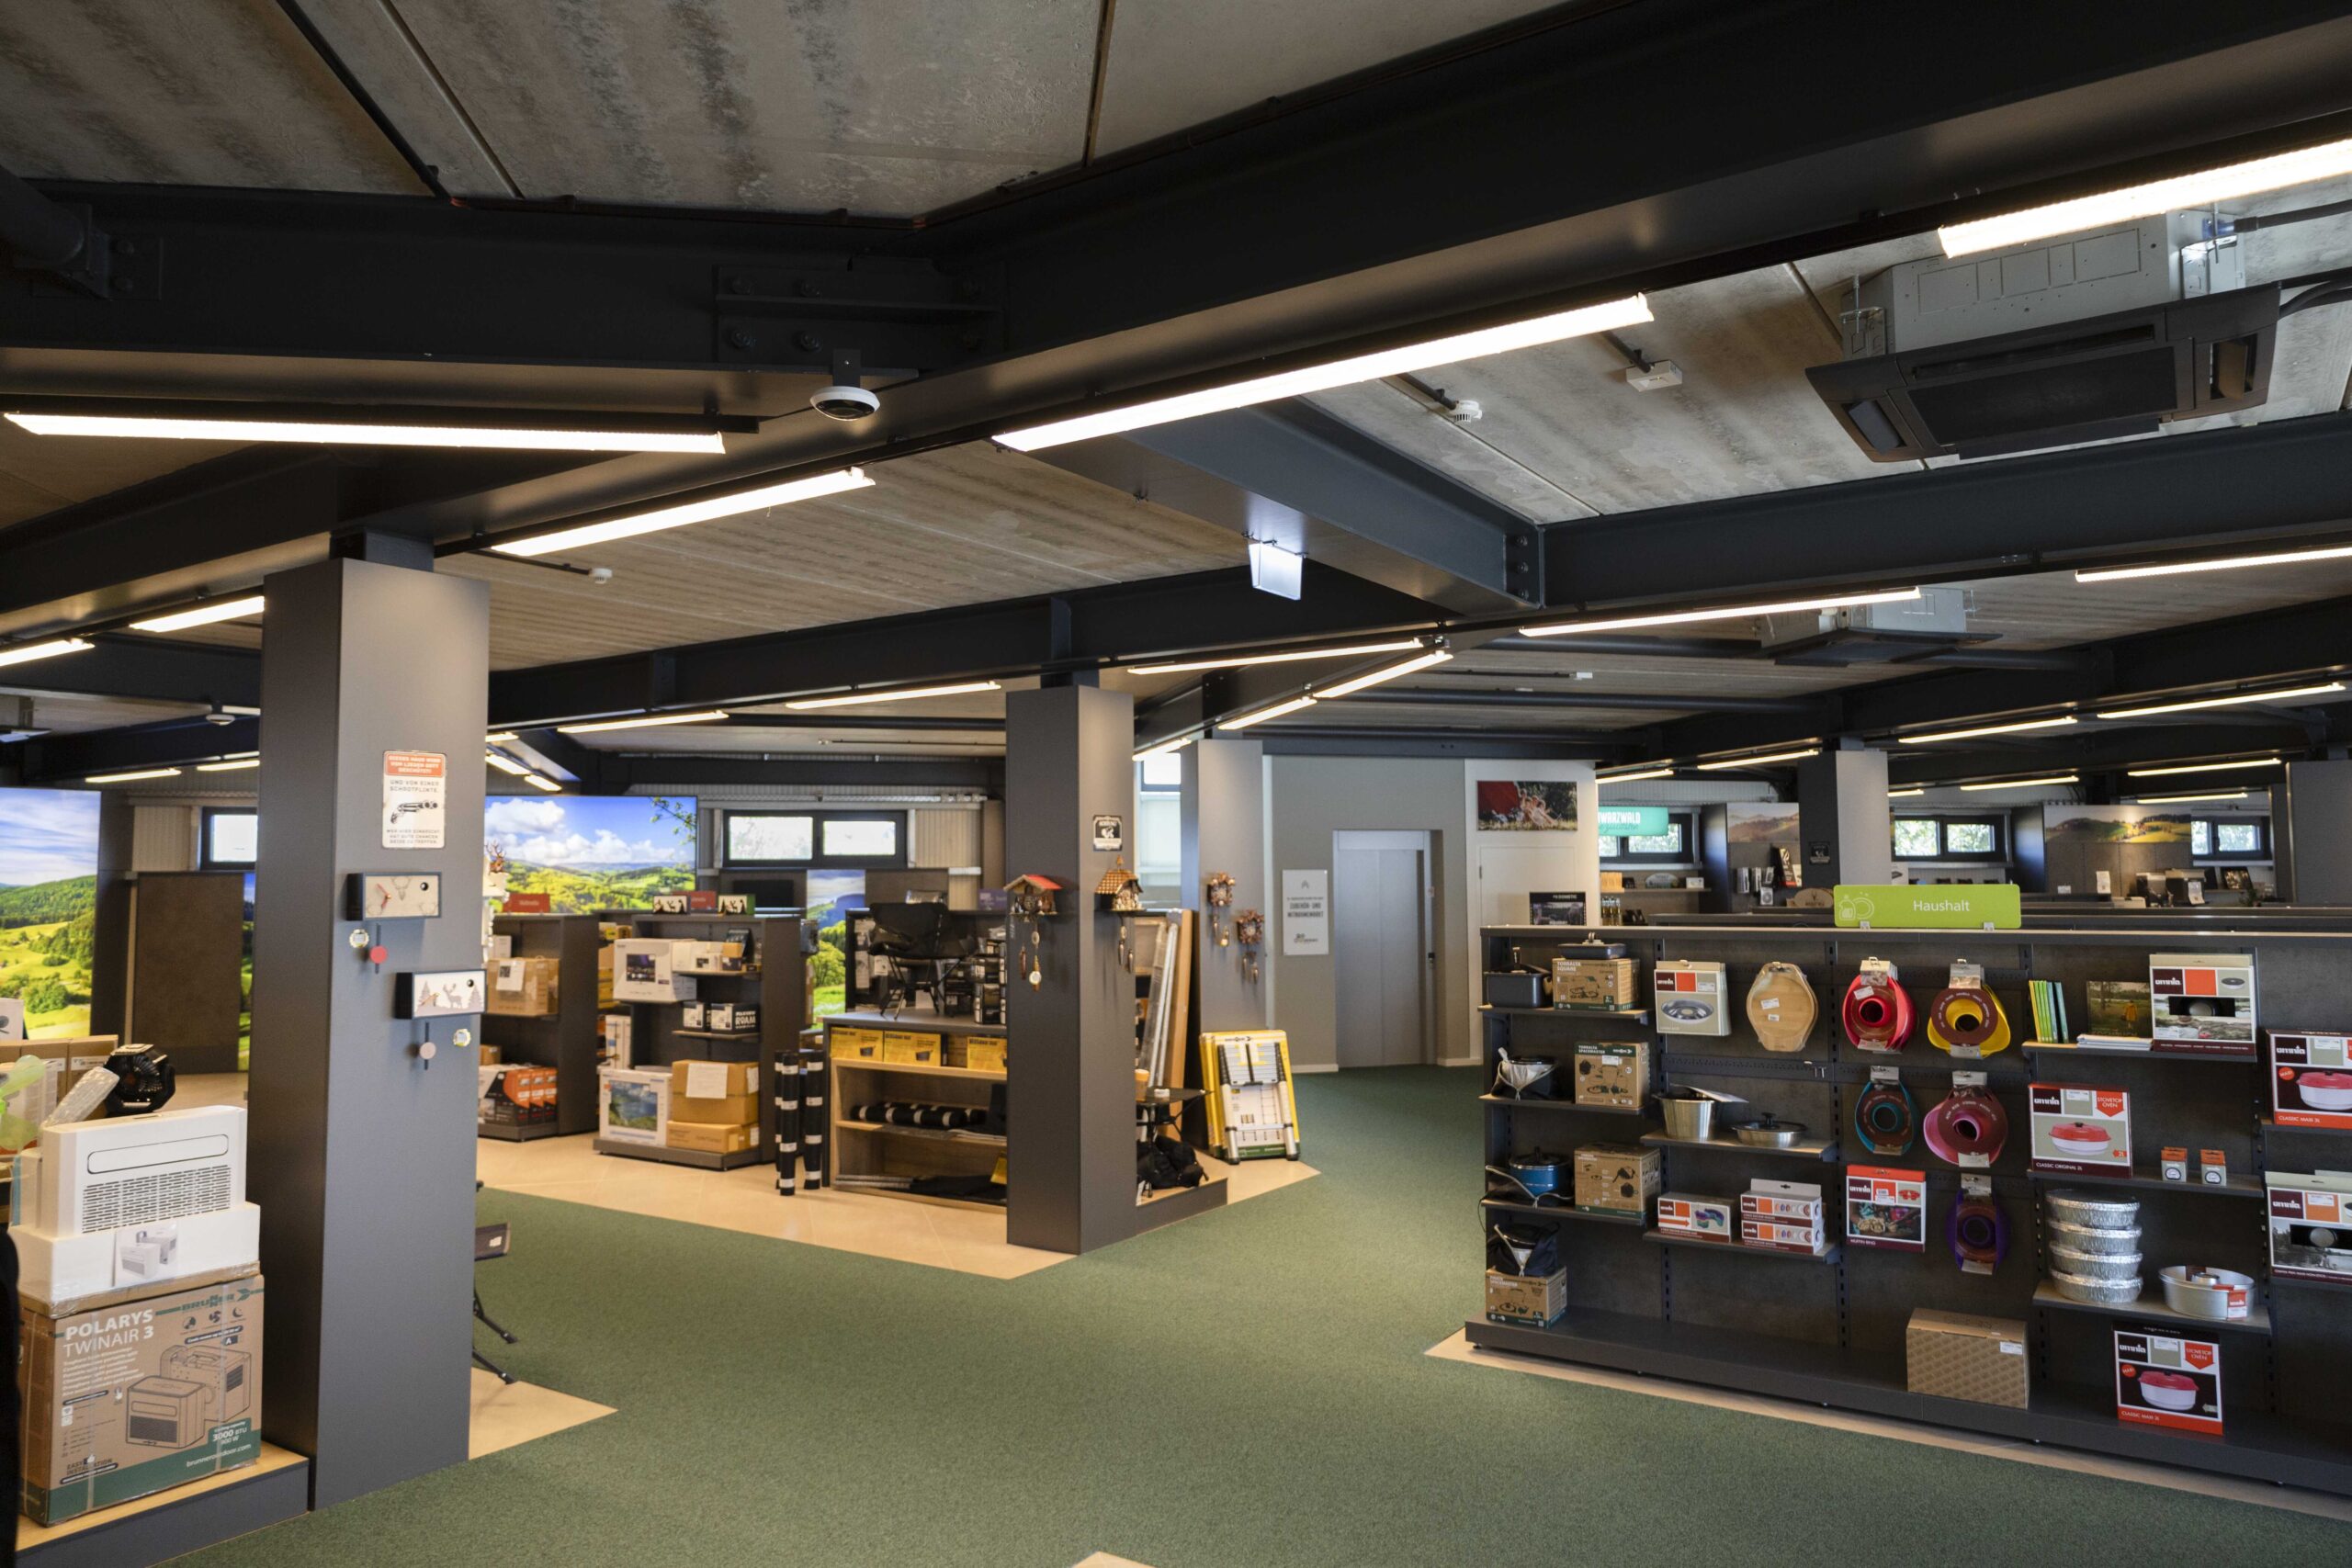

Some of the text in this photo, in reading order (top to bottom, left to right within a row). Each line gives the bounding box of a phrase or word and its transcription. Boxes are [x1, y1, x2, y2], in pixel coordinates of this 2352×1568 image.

[1913, 899, 1970, 912] Haushalt
[2154, 977, 2181, 986] omnia
[735, 1015, 756, 1025] ROAM
[2276, 1045, 2306, 1055] omnia
[2034, 1096, 2060, 1106] omnia
[2272, 1200, 2300, 1209] omnia
[65, 1309, 153, 1341] POLARYS
[62, 1328, 140, 1358] TWINAIR
[143, 1325, 154, 1339] 3
[2119, 1344, 2146, 1353] omnia
[2121, 1410, 2141, 1418] CLASSIC
[212, 1427, 247, 1442] 3000 BTU
